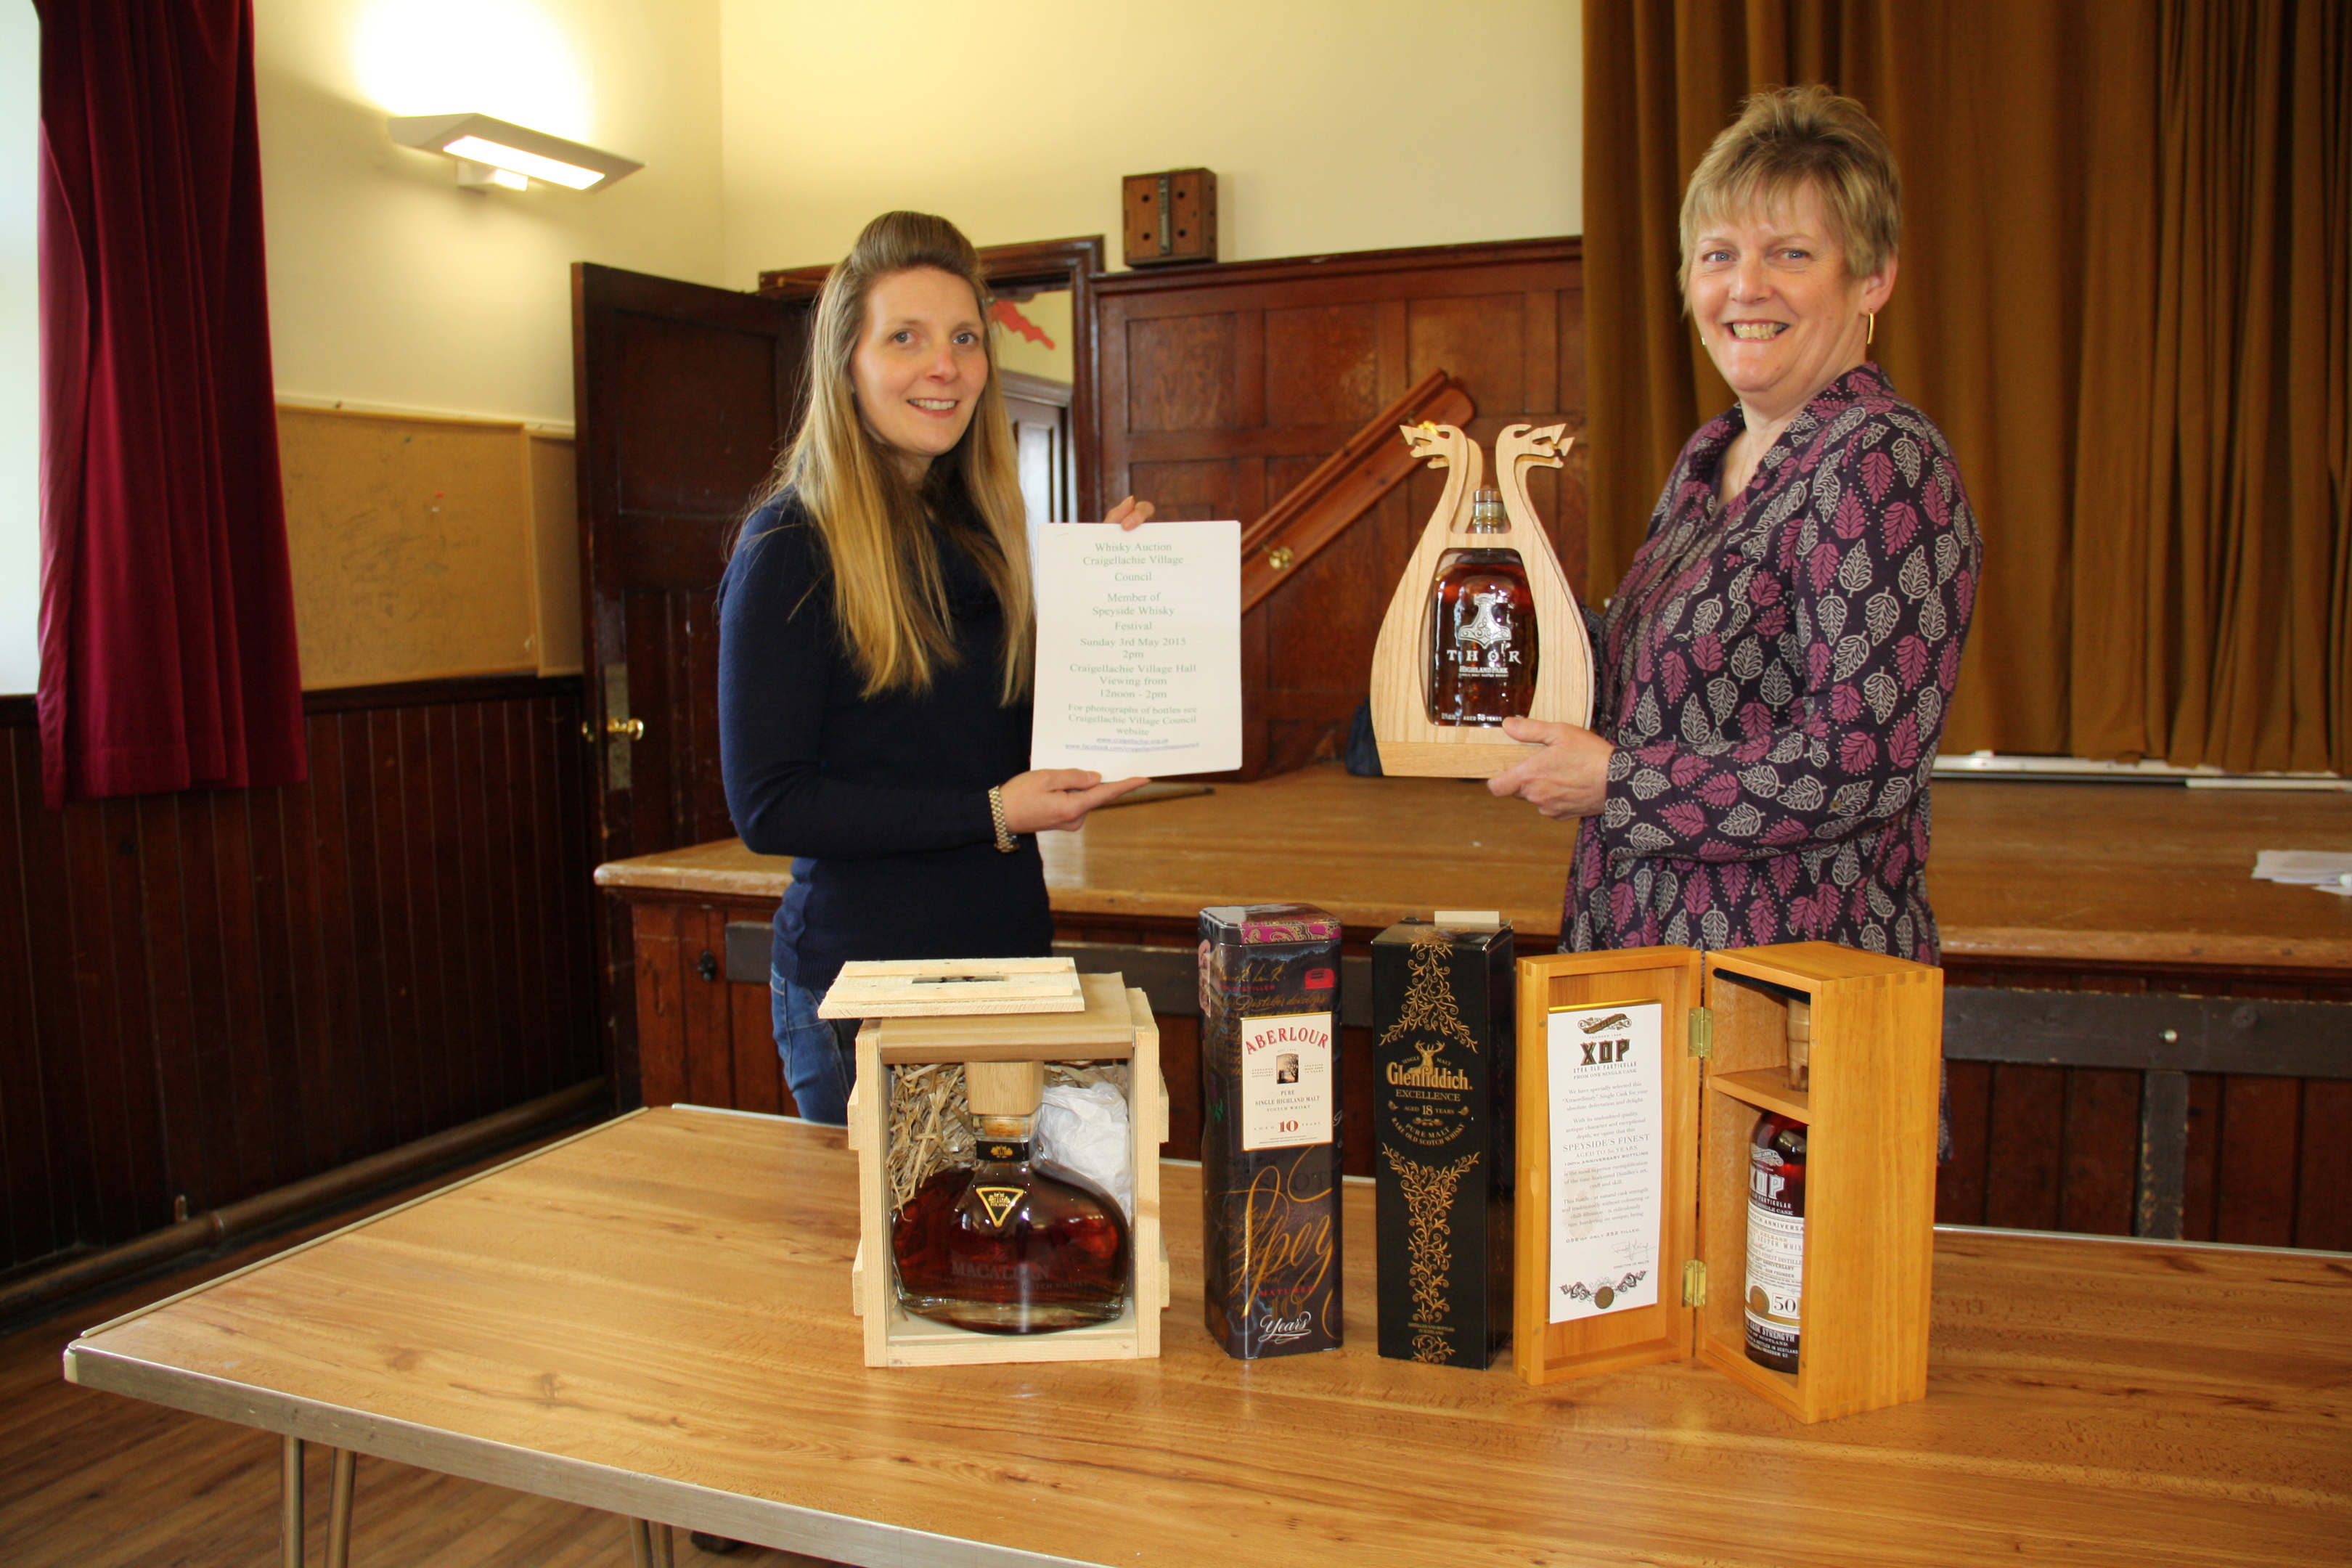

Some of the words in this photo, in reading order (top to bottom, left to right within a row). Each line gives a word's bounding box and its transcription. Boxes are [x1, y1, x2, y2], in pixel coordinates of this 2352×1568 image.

[1095, 543, 1130, 553] Whisky
[1135, 542, 1172, 551] Auction
[1083, 556, 1146, 567] Craigellachie
[1149, 555, 1184, 566] Village
[1114, 572, 1152, 581] Council
[1107, 593, 1147, 603] Member
[1150, 592, 1161, 602] of
[1093, 606, 1135, 617] Speyside
[1139, 606, 1175, 617] Whisky
[1114, 621, 1153, 631] Festival
[1080, 638, 1116, 648] Sunday
[1138, 638, 1160, 648] May
[1163, 637, 1187, 646] 2015
[1123, 650, 1144, 660] 2pm
[1447, 650, 1522, 664] THOR
[1069, 663, 1134, 674] Craigellachie
[1138, 664, 1172, 674] Village
[1100, 677, 1141, 687] Viewing
[1144, 677, 1167, 685] from
[1100, 689, 1135, 698] 12noon
[1146, 690, 1167, 700] 2pm
[1085, 704, 1138, 714] photographs
[1069, 714, 1126, 724] Craigellachie
[1130, 716, 1160, 726] Village
[1162, 716, 1196, 724] Council
[1245, 1026, 1329, 1055] ABERLOUR
[1580, 1038, 1630, 1066] XOP
[1402, 1055, 1421, 1064] SINGLE
[1437, 1058, 1451, 1066] MALT
[1603, 1061, 1637, 1070] PARTICULAR
[1387, 1061, 1470, 1090] Glenfiddich
[1395, 1089, 1461, 1102] EXCELLENCE
[1422, 1105, 1433, 1116] 18
[1278, 1119, 1299, 1133] 10
[1391, 1117, 1405, 1135] RARE
[1405, 1132, 1418, 1143] OLD
[1445, 1122, 1465, 1142] WHISKY
[1405, 1123, 1426, 1138] PURE
[1429, 1126, 1450, 1138] MALT
[1562, 1138, 1616, 1152] SPEYSIDE'S
[1618, 1134, 1650, 1145] FINEST
[1576, 1149, 1595, 1159] AGED
[1582, 1155, 1620, 1164] ANNIVERSARY
[1757, 1235, 1779, 1247] SCOTCH
[1259, 1286, 1315, 1297] MATURED
[1773, 1296, 1796, 1312] 50
[1258, 1311, 1312, 1344] Years
[1762, 1327, 1794, 1342] STRENGTH
[1759, 1335, 1789, 1346] SCOTLAND
